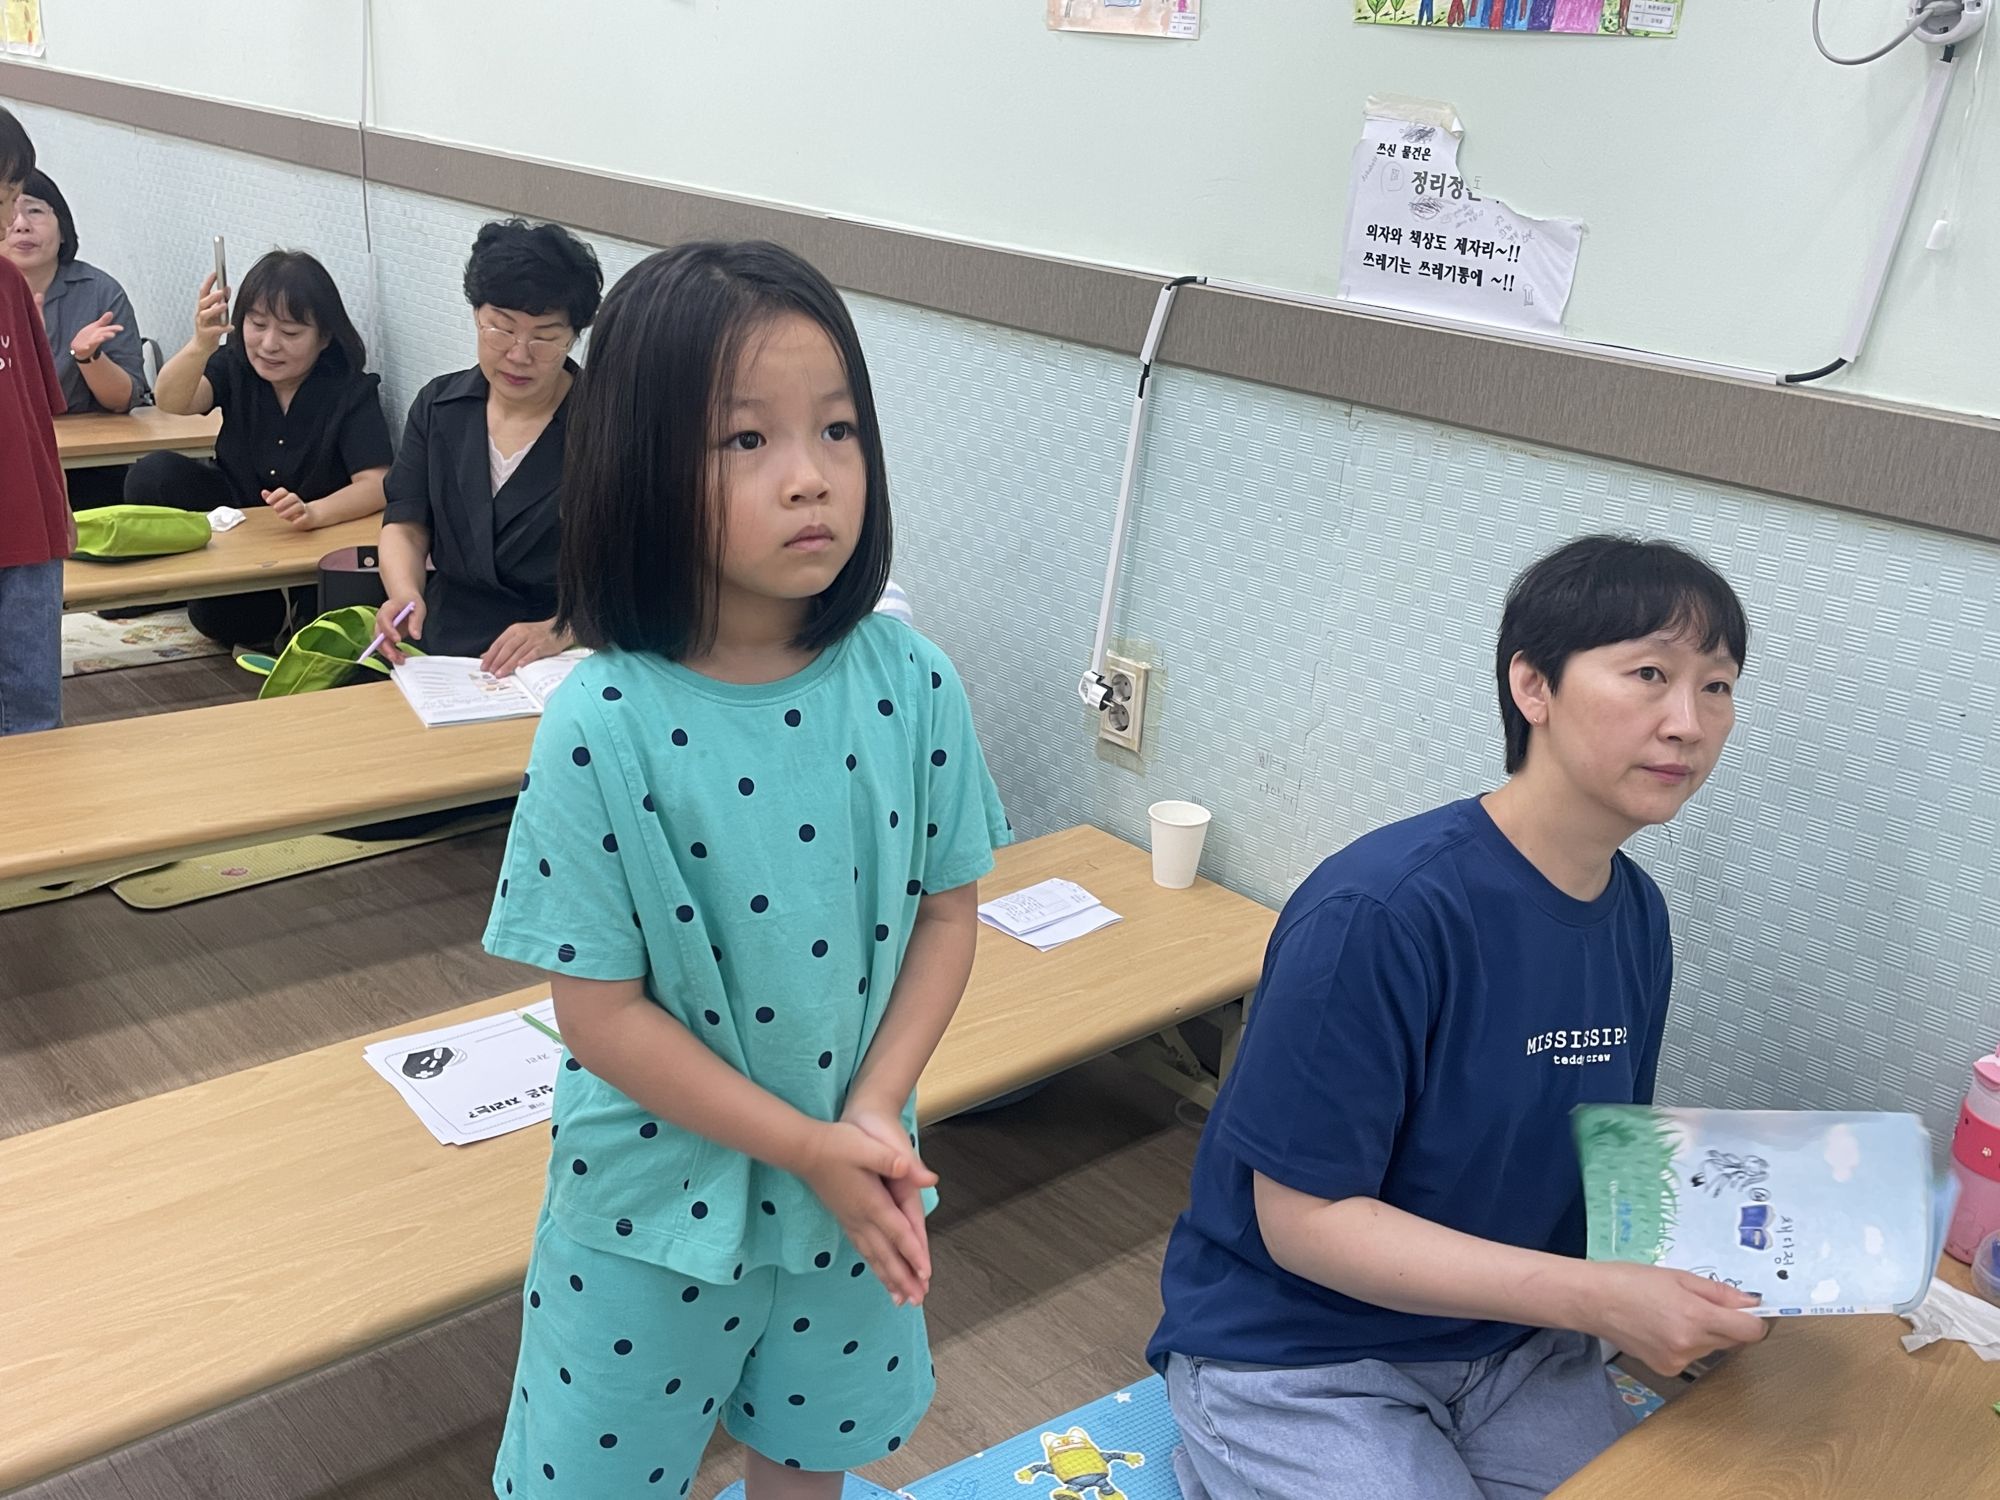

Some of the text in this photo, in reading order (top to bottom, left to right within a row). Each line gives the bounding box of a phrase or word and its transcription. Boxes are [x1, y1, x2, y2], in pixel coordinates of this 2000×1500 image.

[1376, 143, 1431, 161] 쓰신 물건은
[1366, 224, 1403, 245] 의자와
[1409, 230, 1447, 251] 책상도
[1363, 252, 1411, 274] 쓰레기는
[1418, 261, 1483, 287] 쓰레기통에
